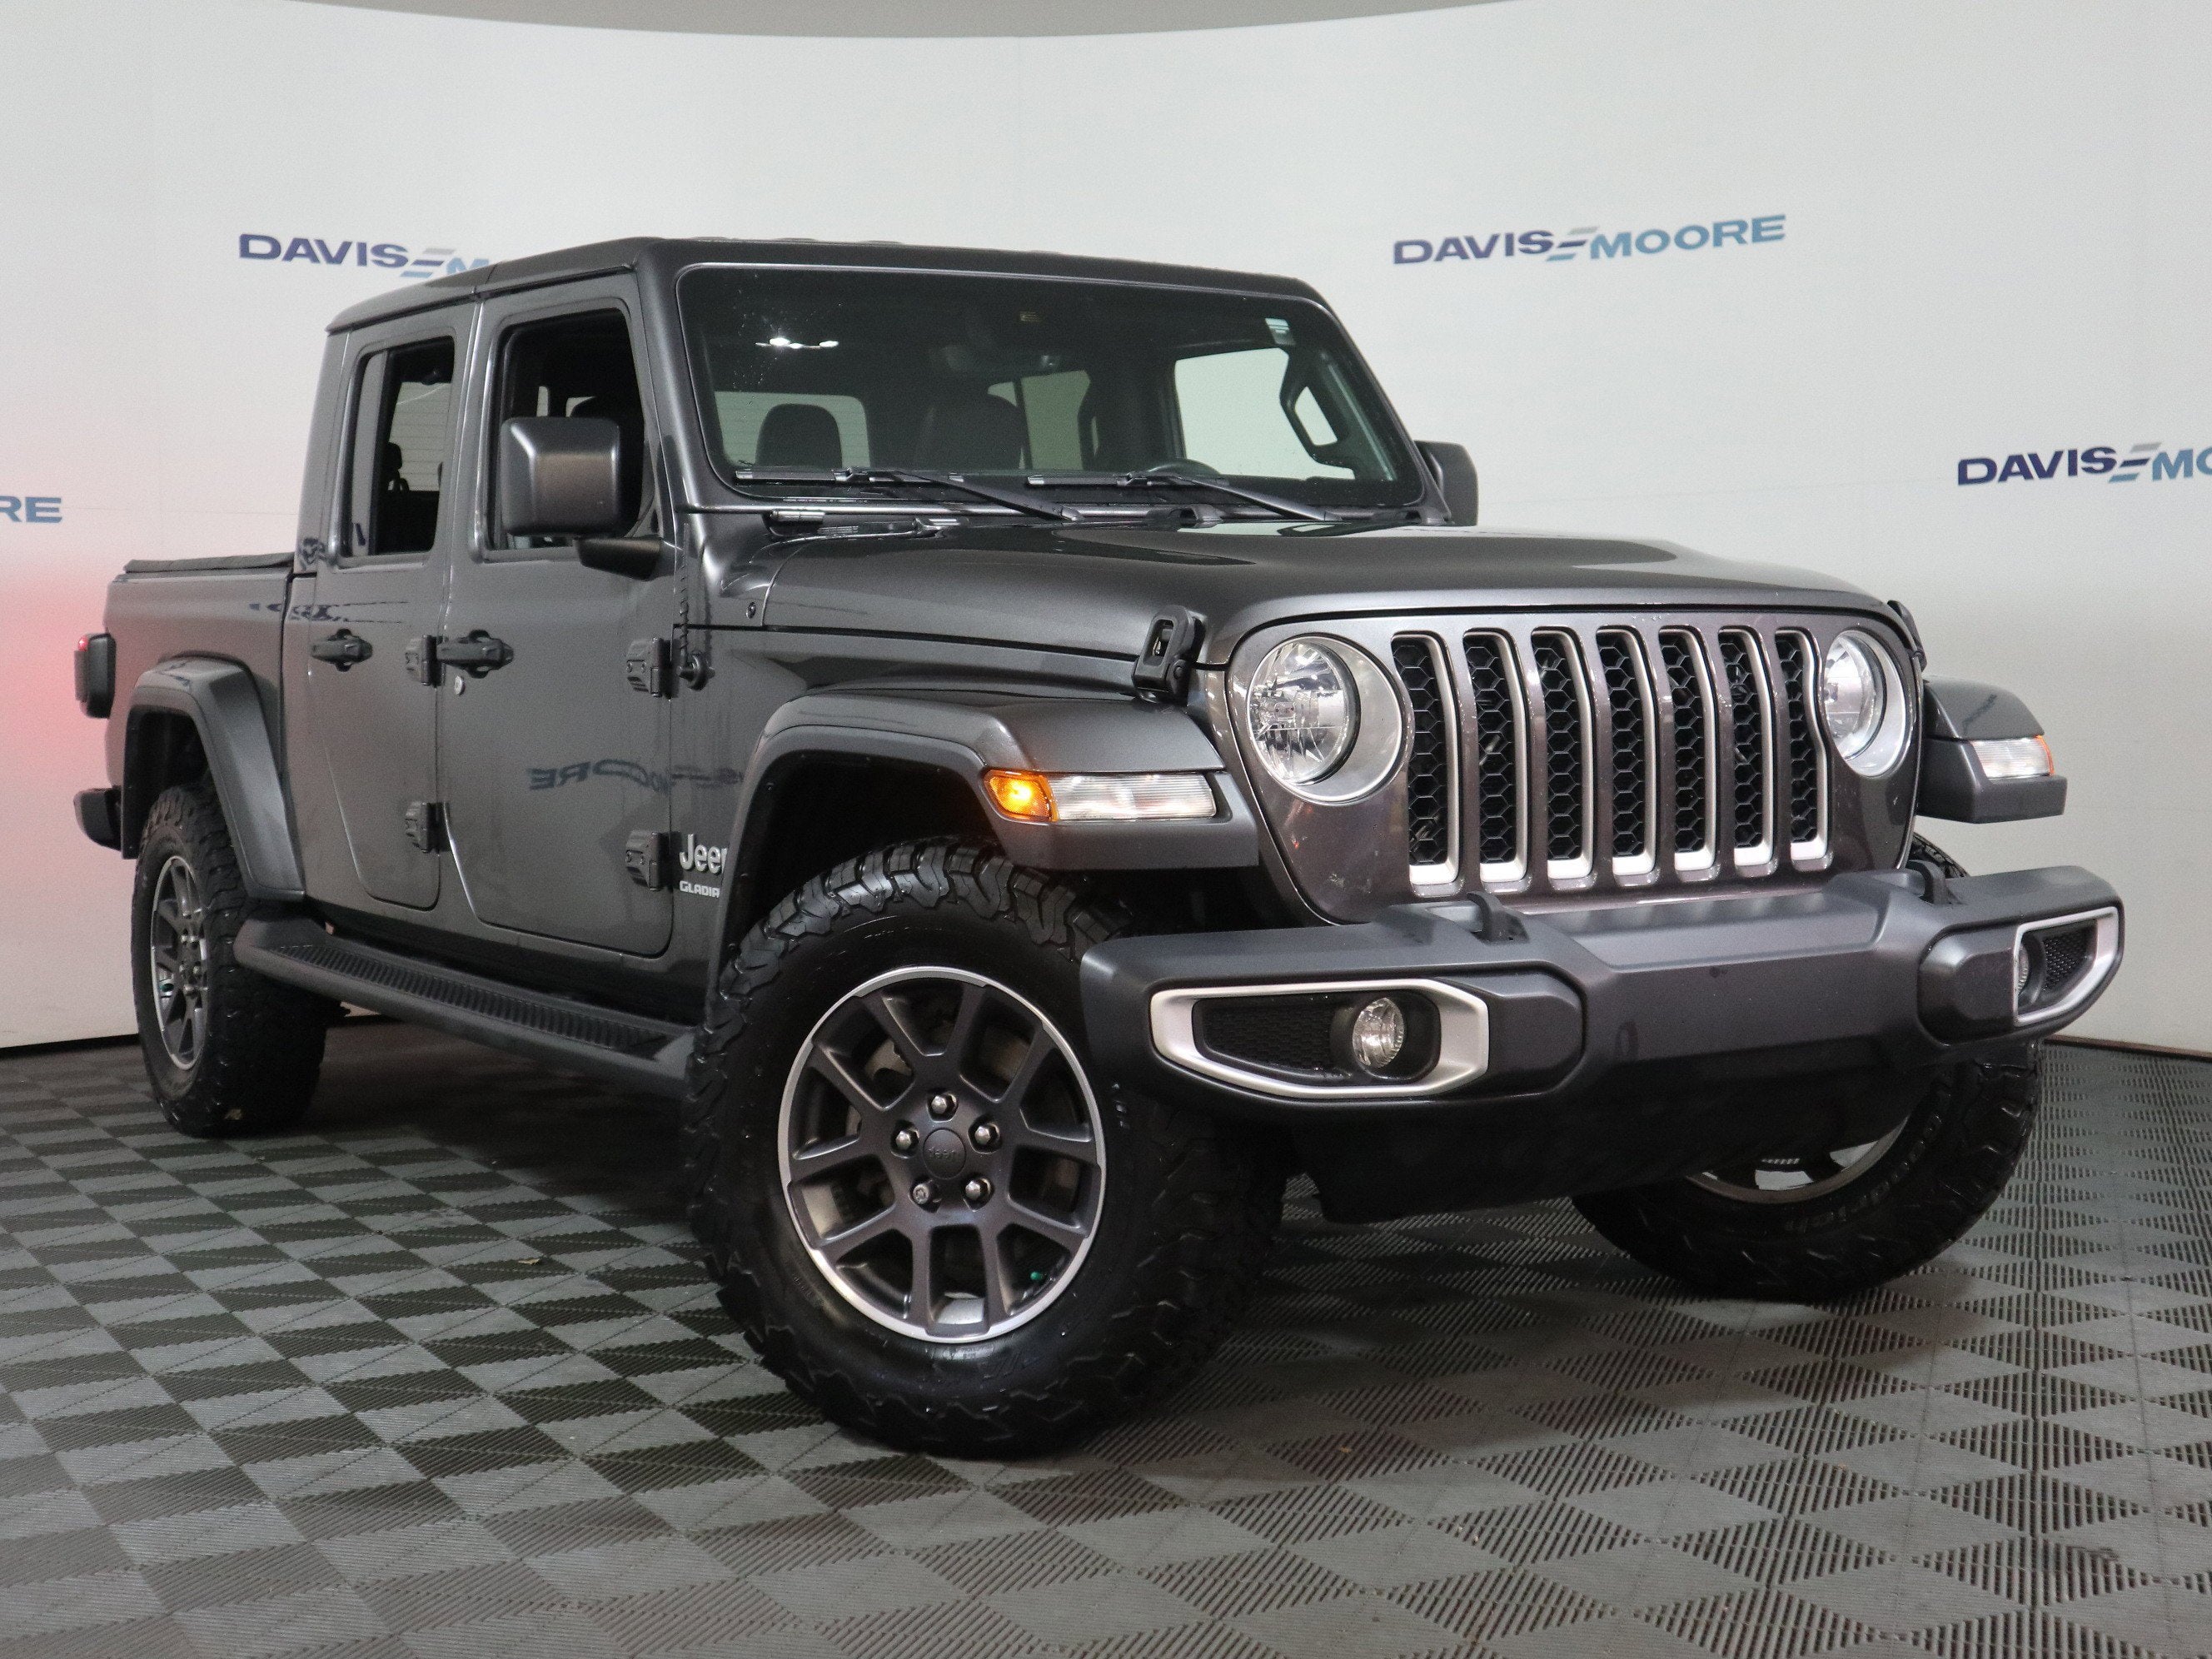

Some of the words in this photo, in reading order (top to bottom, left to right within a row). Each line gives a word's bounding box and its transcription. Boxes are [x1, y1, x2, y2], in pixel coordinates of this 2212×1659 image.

[238, 233, 409, 268] DAVIS
[1393, 230, 1554, 264] DAVIS
[1589, 214, 1786, 260] MOORE
[1957, 446, 2117, 485] DAVIS
